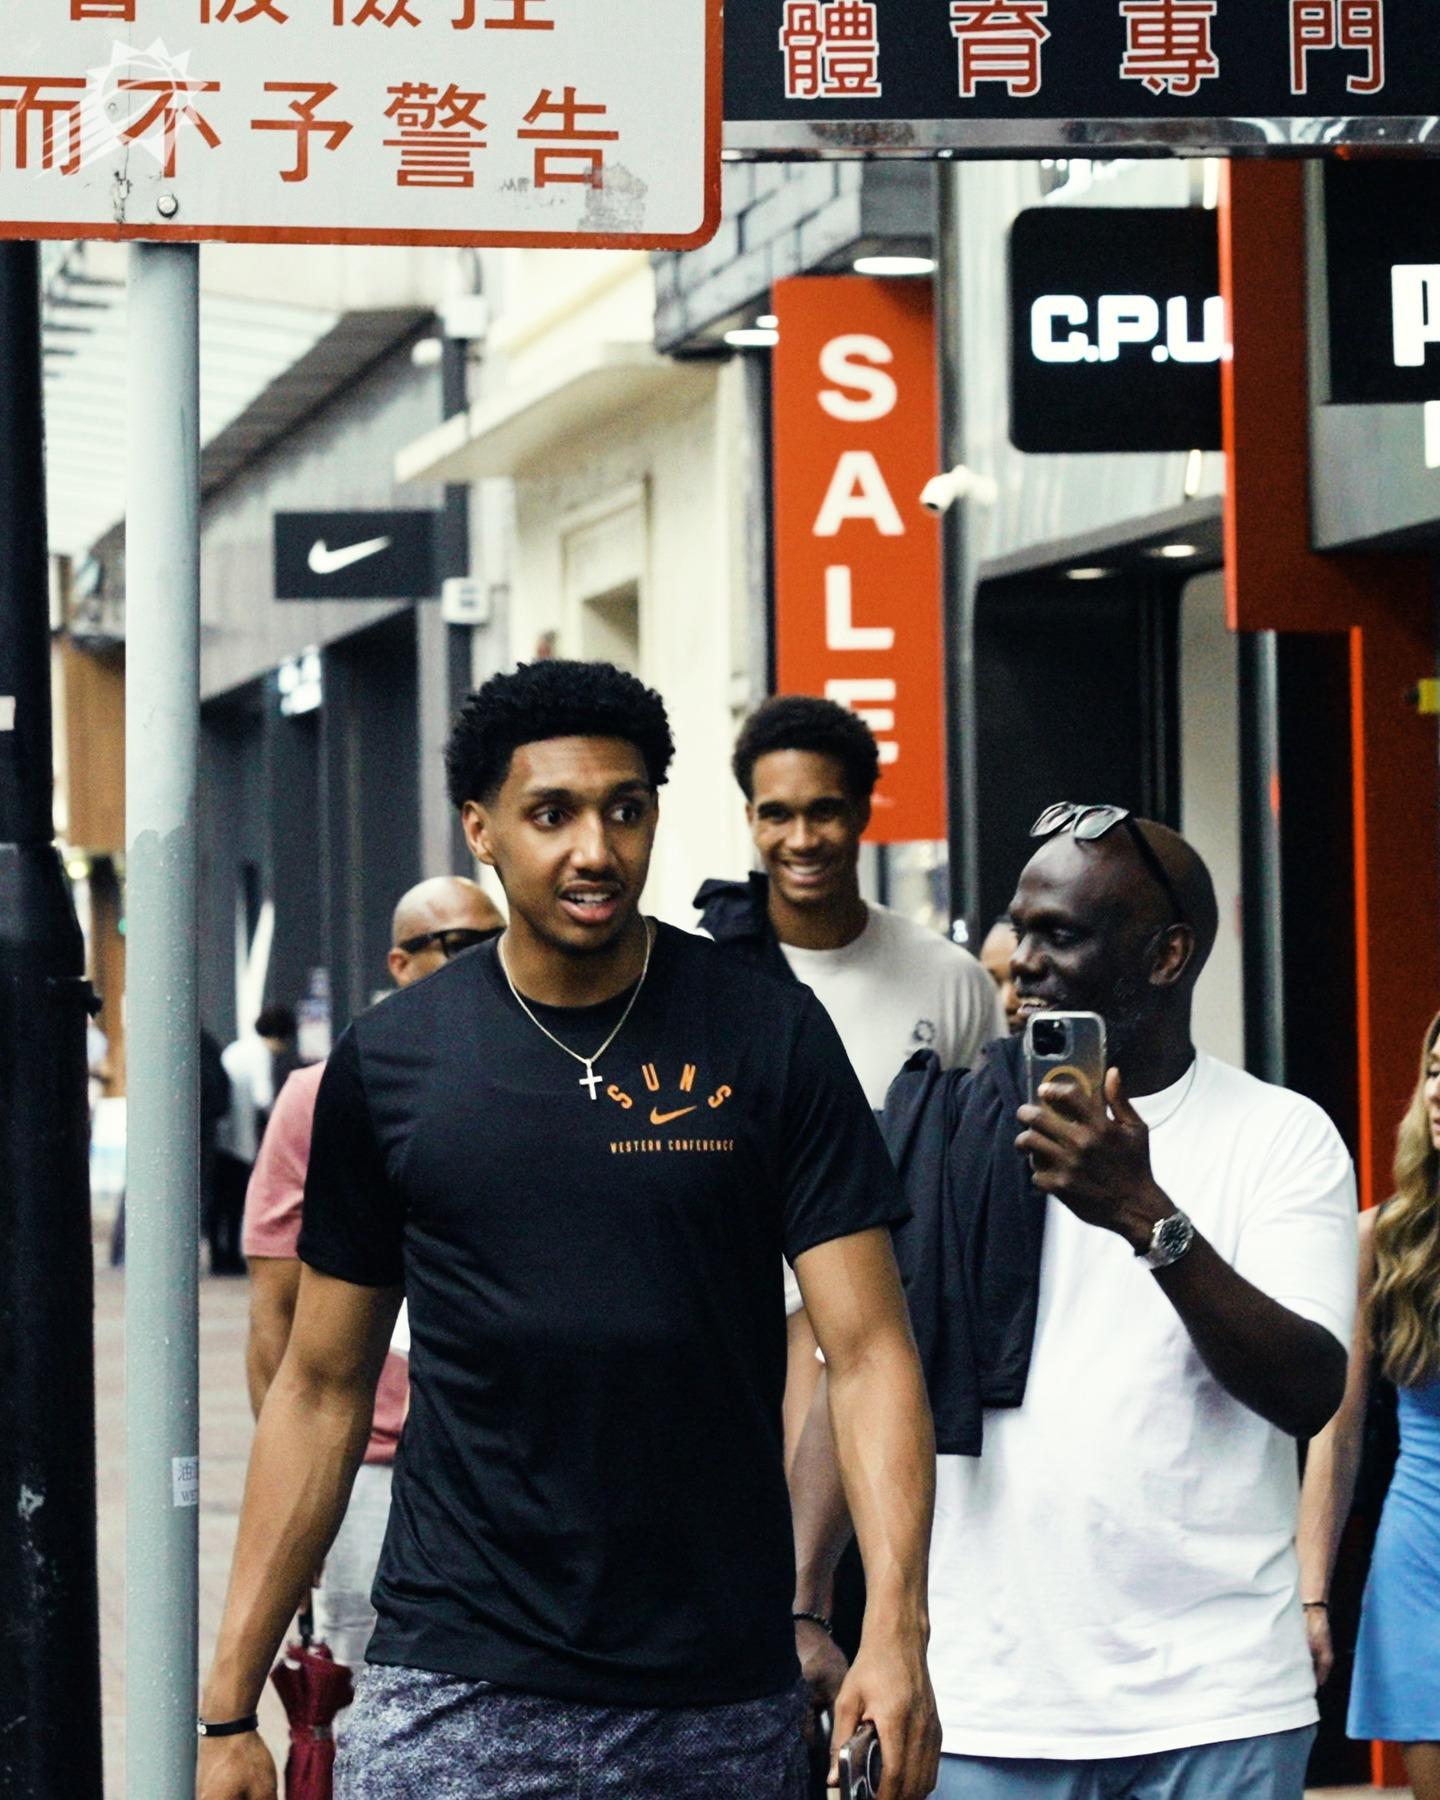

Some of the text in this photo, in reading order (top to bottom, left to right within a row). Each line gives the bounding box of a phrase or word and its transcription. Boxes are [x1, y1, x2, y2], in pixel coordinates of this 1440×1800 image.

[0, 76, 619, 189] 而不予警告
[812, 333, 905, 764] SALE
[607, 1063, 732, 1109] SUNS
[610, 1139, 734, 1154] WESTERN CONFERENCE
